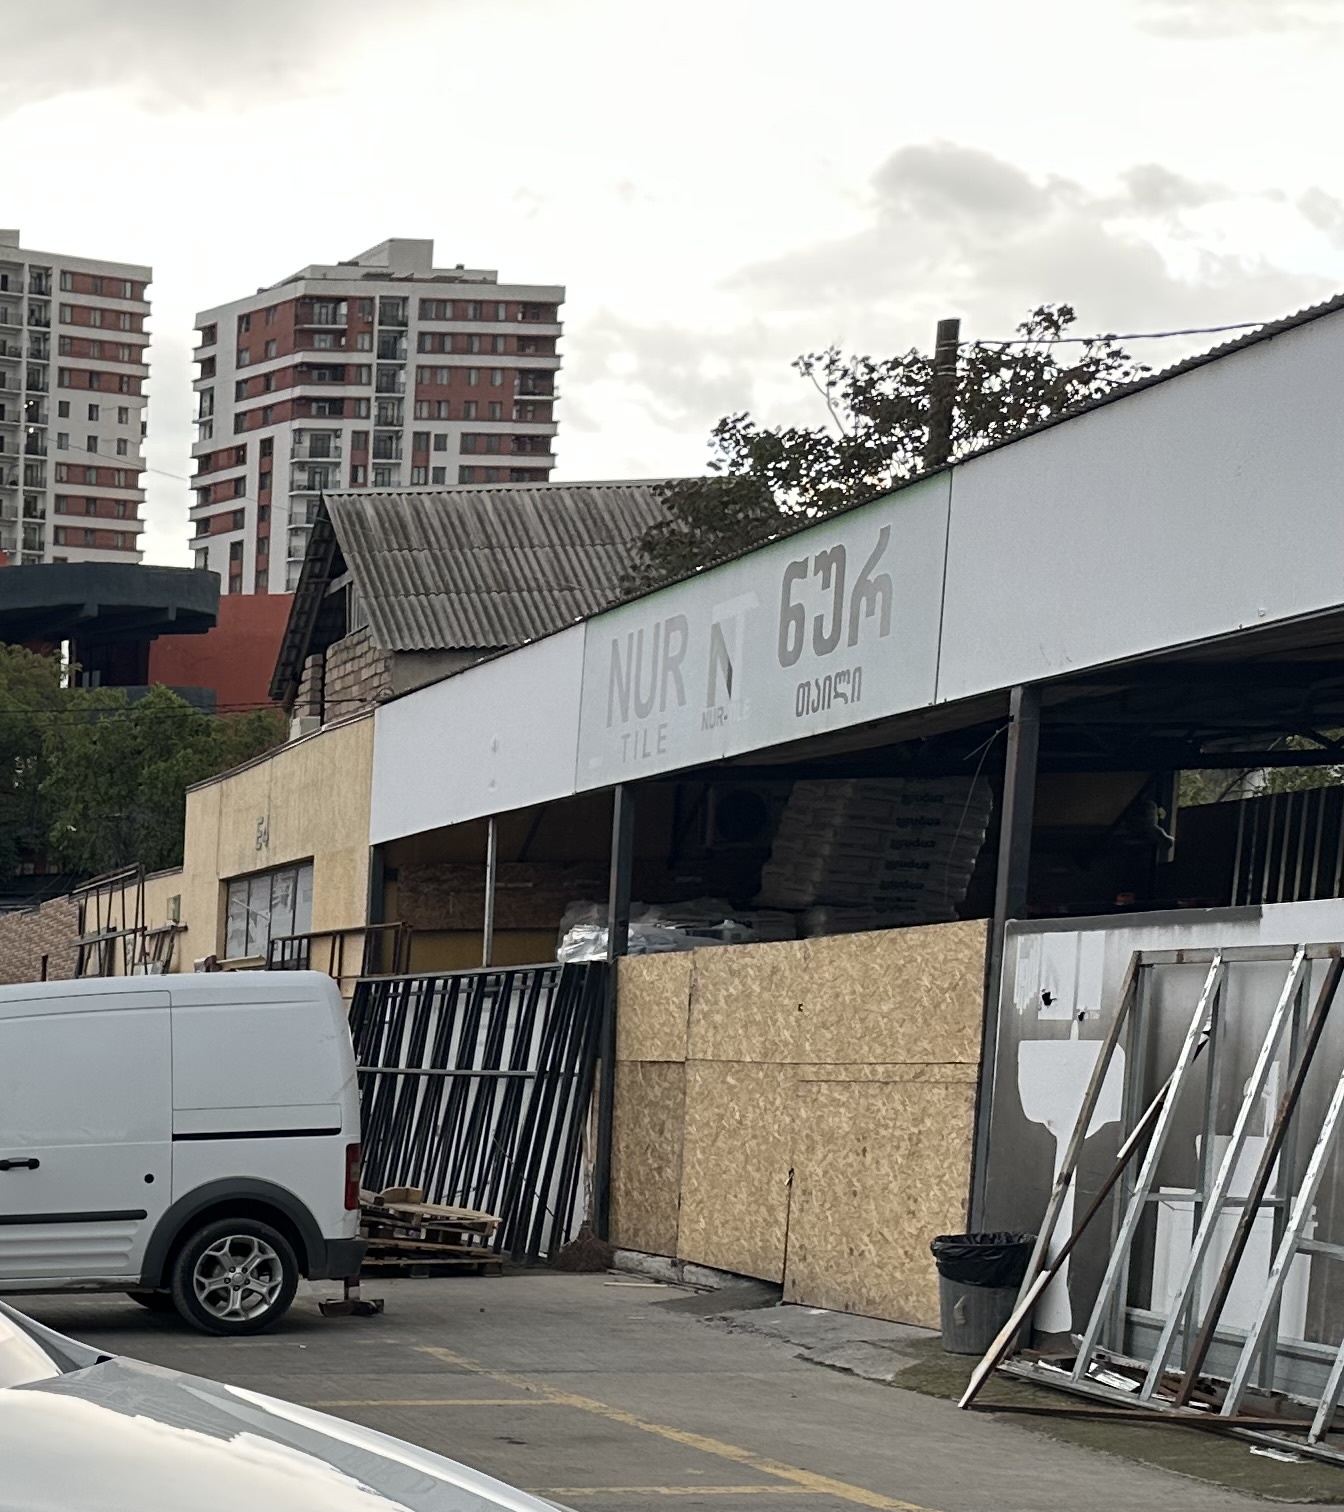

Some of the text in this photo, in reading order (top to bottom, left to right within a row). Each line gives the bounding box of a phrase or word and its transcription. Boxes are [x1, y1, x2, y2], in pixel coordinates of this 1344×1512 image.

[777, 524, 893, 669] ნურ
[607, 614, 689, 729] NUR
[795, 666, 863, 718] თაილი
[621, 723, 668, 764] TILE
[255, 816, 270, 851] E4
